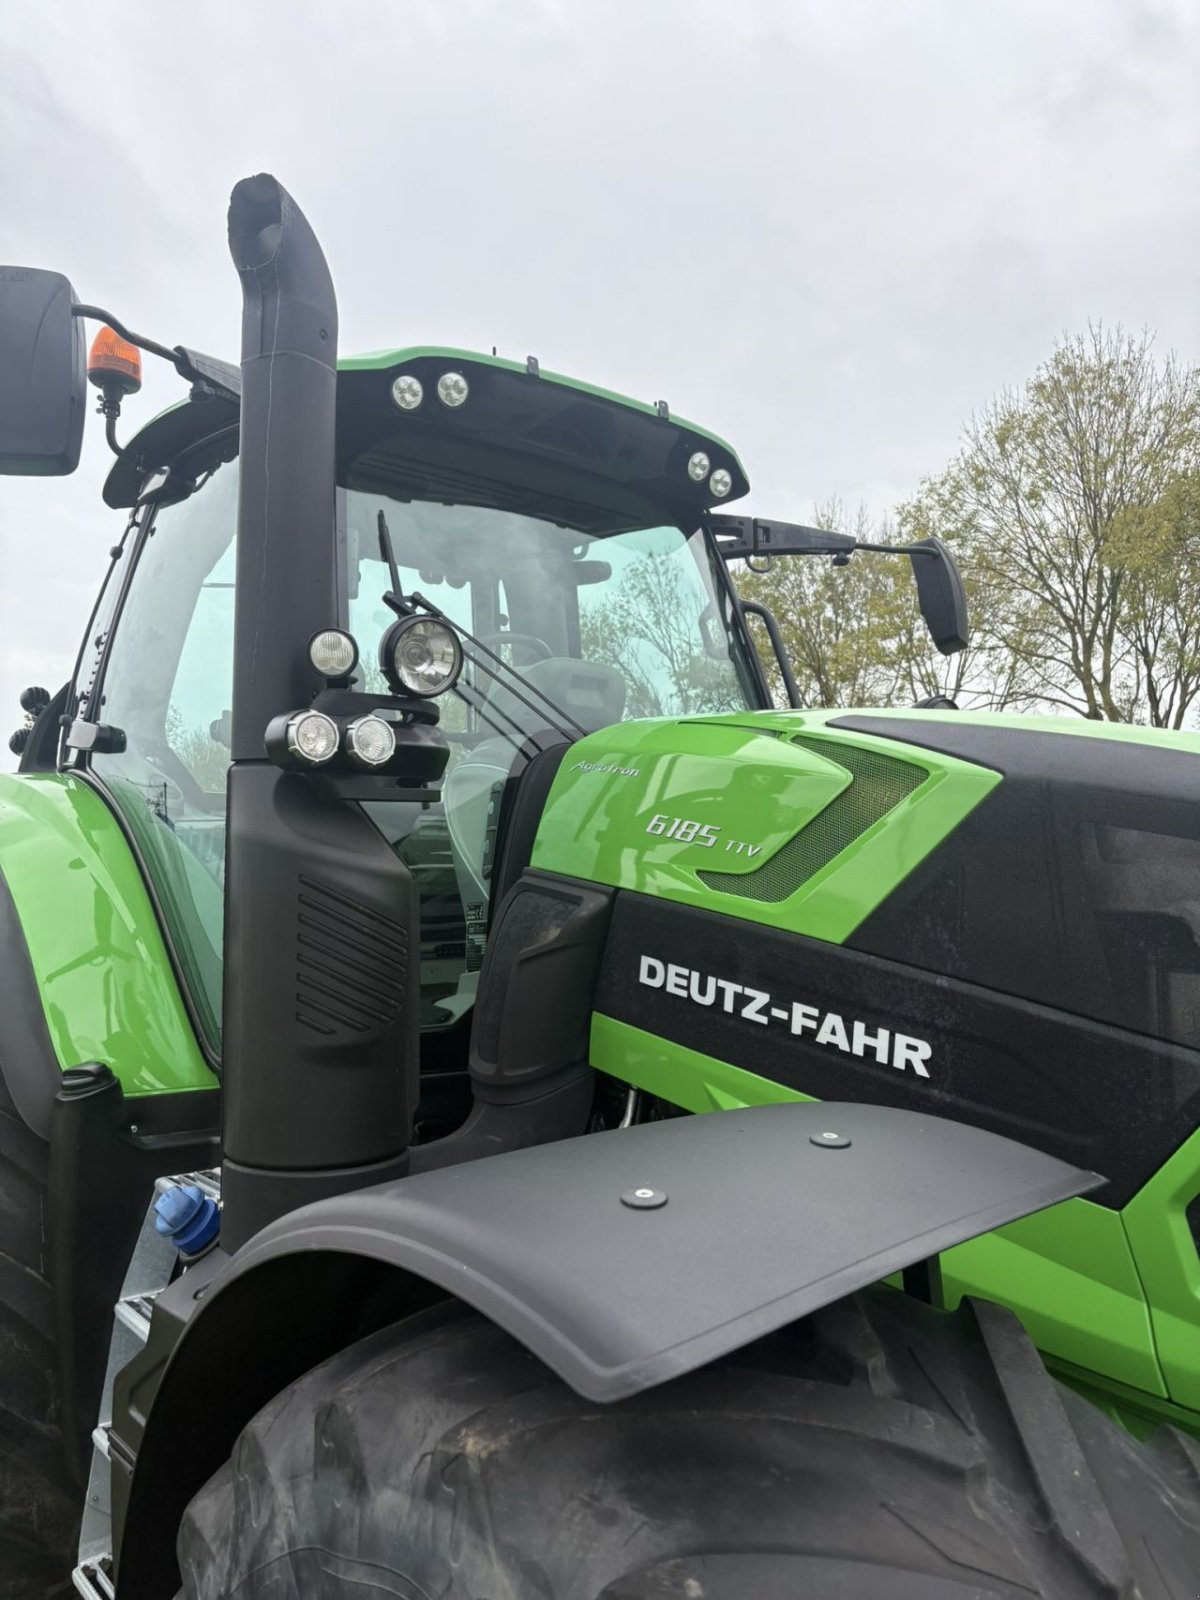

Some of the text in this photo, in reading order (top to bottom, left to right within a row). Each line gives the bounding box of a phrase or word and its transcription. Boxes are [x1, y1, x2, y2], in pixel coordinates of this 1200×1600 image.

[569, 760, 640, 777] Agrotron
[646, 814, 763, 857] 6185 TTV
[638, 955, 933, 1078] DEUTZ-FAHR
